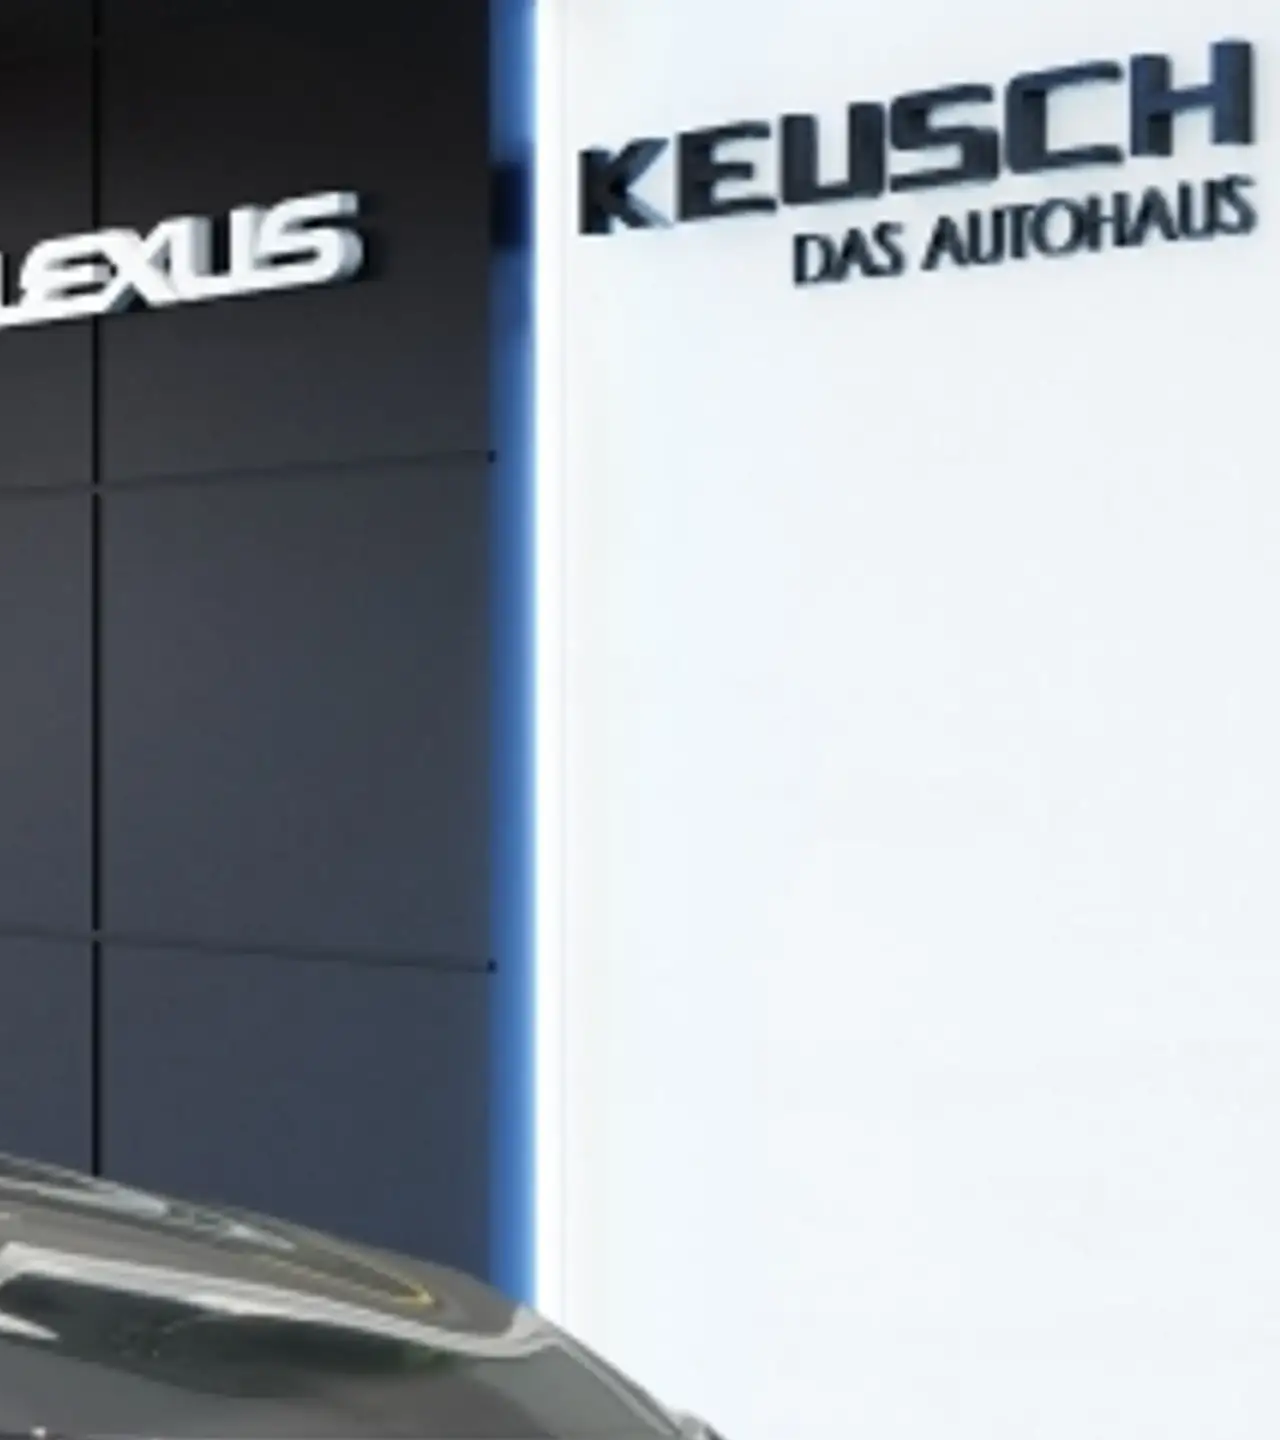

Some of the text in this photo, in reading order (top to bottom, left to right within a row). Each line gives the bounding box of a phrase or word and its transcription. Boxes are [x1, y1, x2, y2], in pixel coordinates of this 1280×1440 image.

[578, 38, 1256, 236] KEUSCH
[793, 175, 1259, 287] DAS AUTOHAUS
